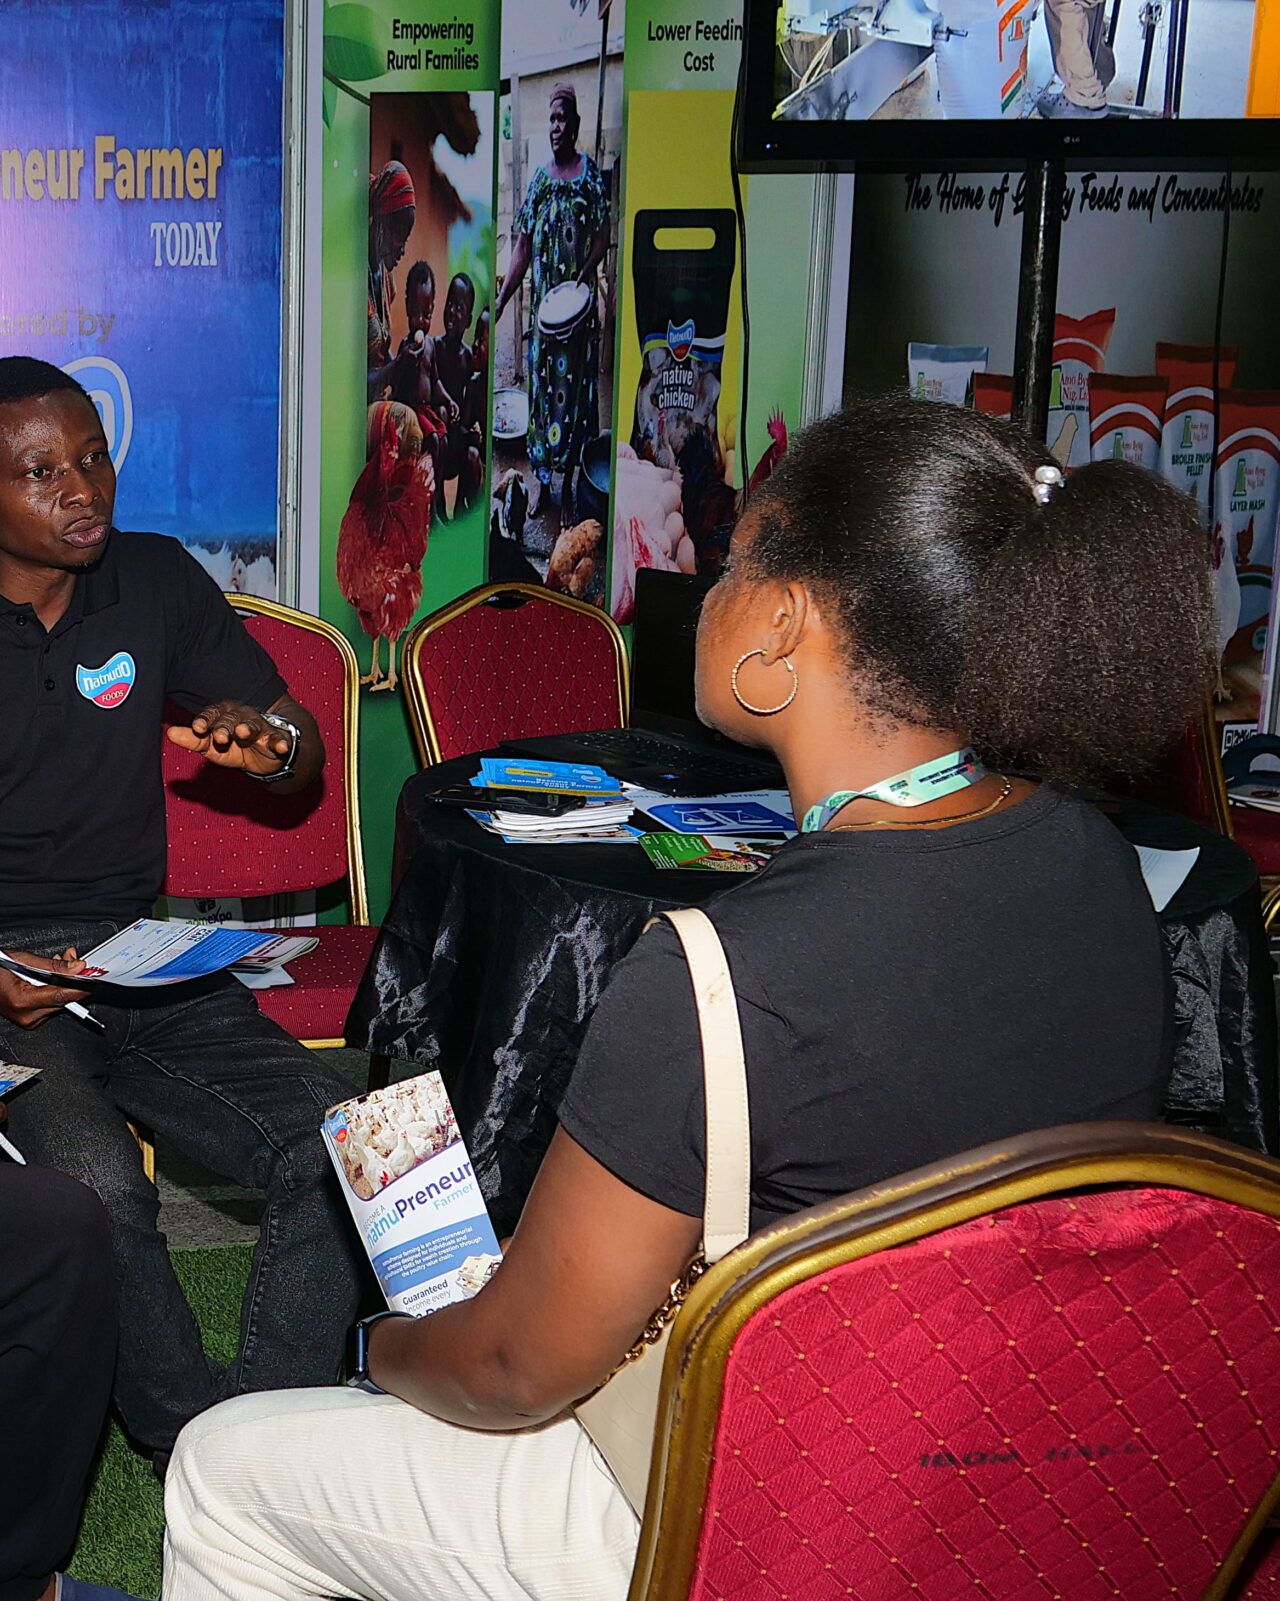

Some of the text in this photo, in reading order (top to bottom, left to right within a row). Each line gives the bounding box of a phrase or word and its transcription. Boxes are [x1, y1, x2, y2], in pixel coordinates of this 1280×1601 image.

[392, 16, 475, 45] Empowering
[647, 19, 743, 42] Lower Feedin
[386, 48, 480, 71] Rural Families
[683, 50, 716, 73] Cost
[94, 136, 223, 201] Farmer
[904, 173, 932, 213] The
[937, 173, 986, 214] Home
[988, 172, 1010, 228] of
[1079, 172, 1123, 212] Feeds
[1127, 173, 1160, 223] and
[150, 221, 222, 267] TODAY
[77, 307, 116, 343] by
[662, 365, 694, 386] native
[1061, 373, 1076, 385] Amo
[658, 387, 696, 411] chicken
[1172, 454, 1194, 465] BROILER
[1186, 465, 1204, 476] PELLET
[1230, 500, 1265, 512] LAYER MASH
[101, 690, 124, 702] FOODS
[433, 1182, 474, 1211] Farmer
[432, 1226, 473, 1246] entrepreneurial
[455, 1235, 467, 1244] and
[459, 1236, 483, 1251] through
[402, 1279, 449, 1306] Guaranteed
[431, 1289, 452, 1306] every
